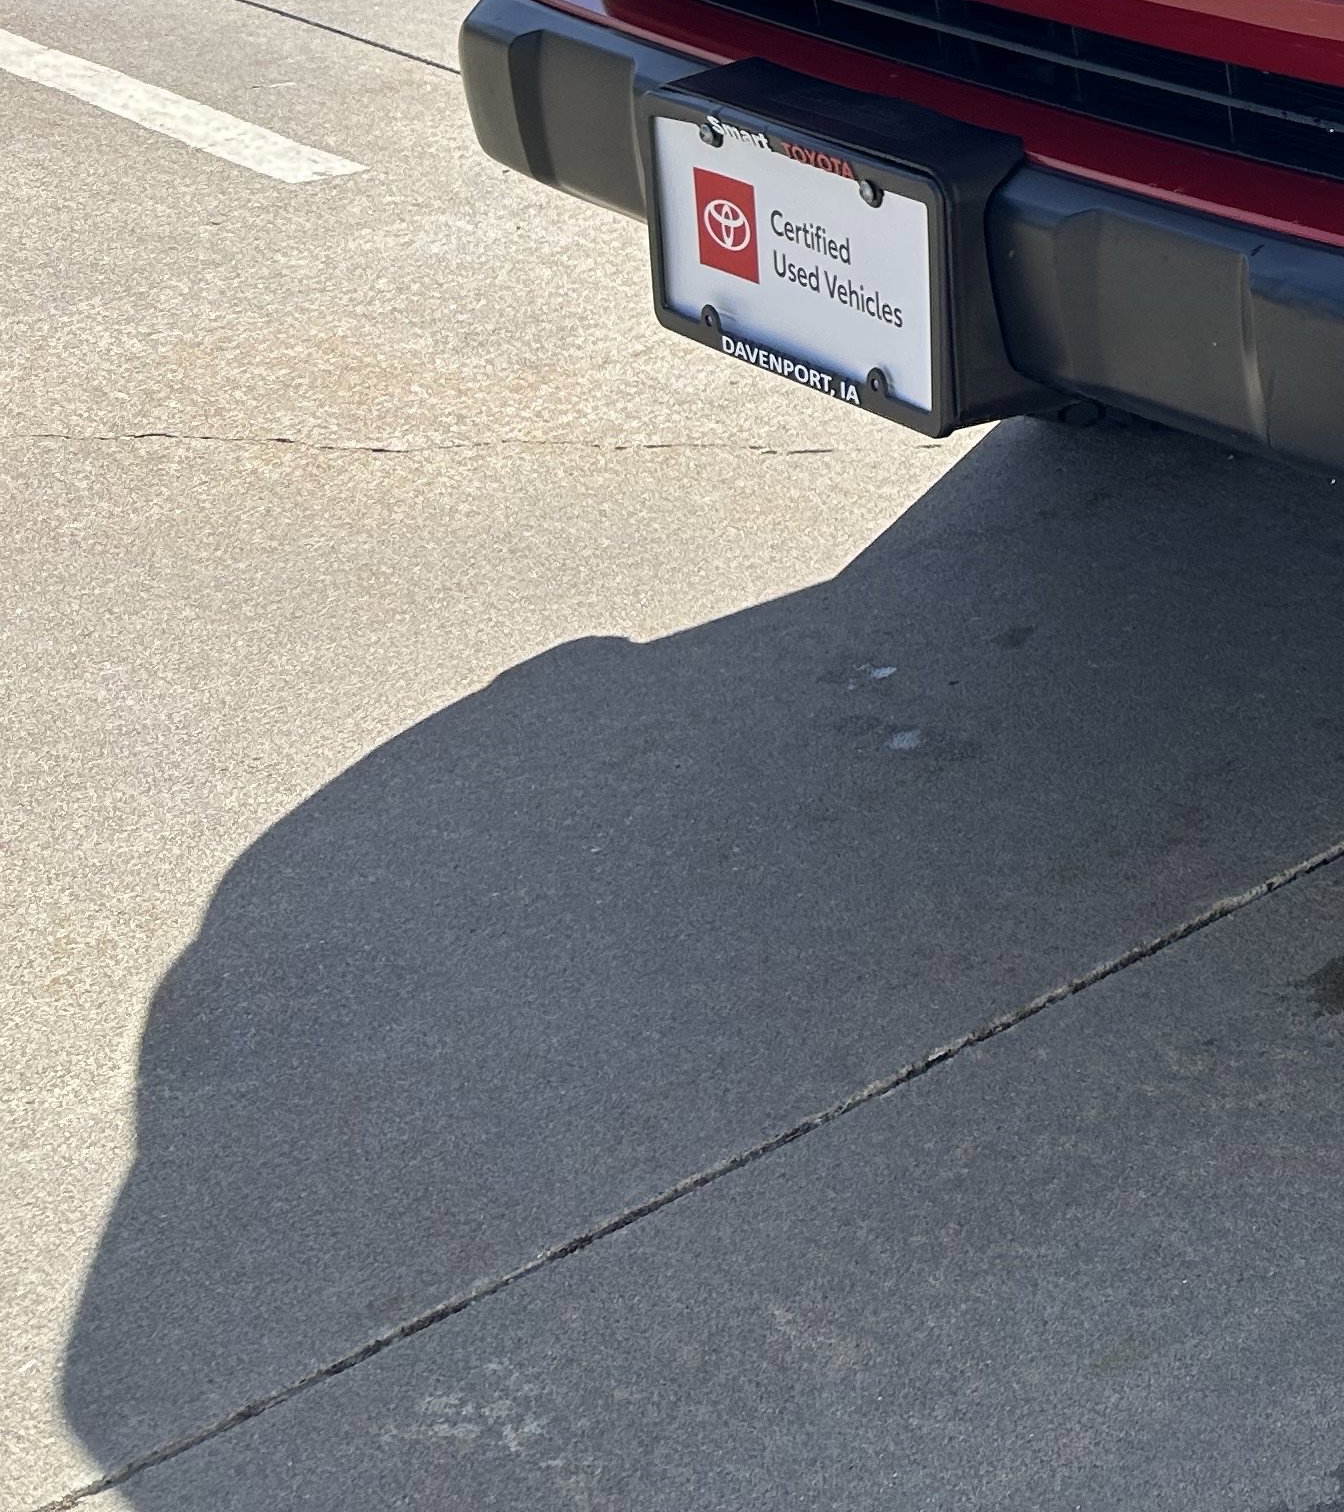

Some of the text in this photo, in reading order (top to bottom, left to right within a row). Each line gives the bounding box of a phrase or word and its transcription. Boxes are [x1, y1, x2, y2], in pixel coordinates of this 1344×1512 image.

[706, 115, 855, 180] Smart TOYOTA
[770, 209, 851, 265] Certified
[773, 249, 903, 328] Used Vehicles
[722, 335, 860, 405] DAVENPORT, IA
